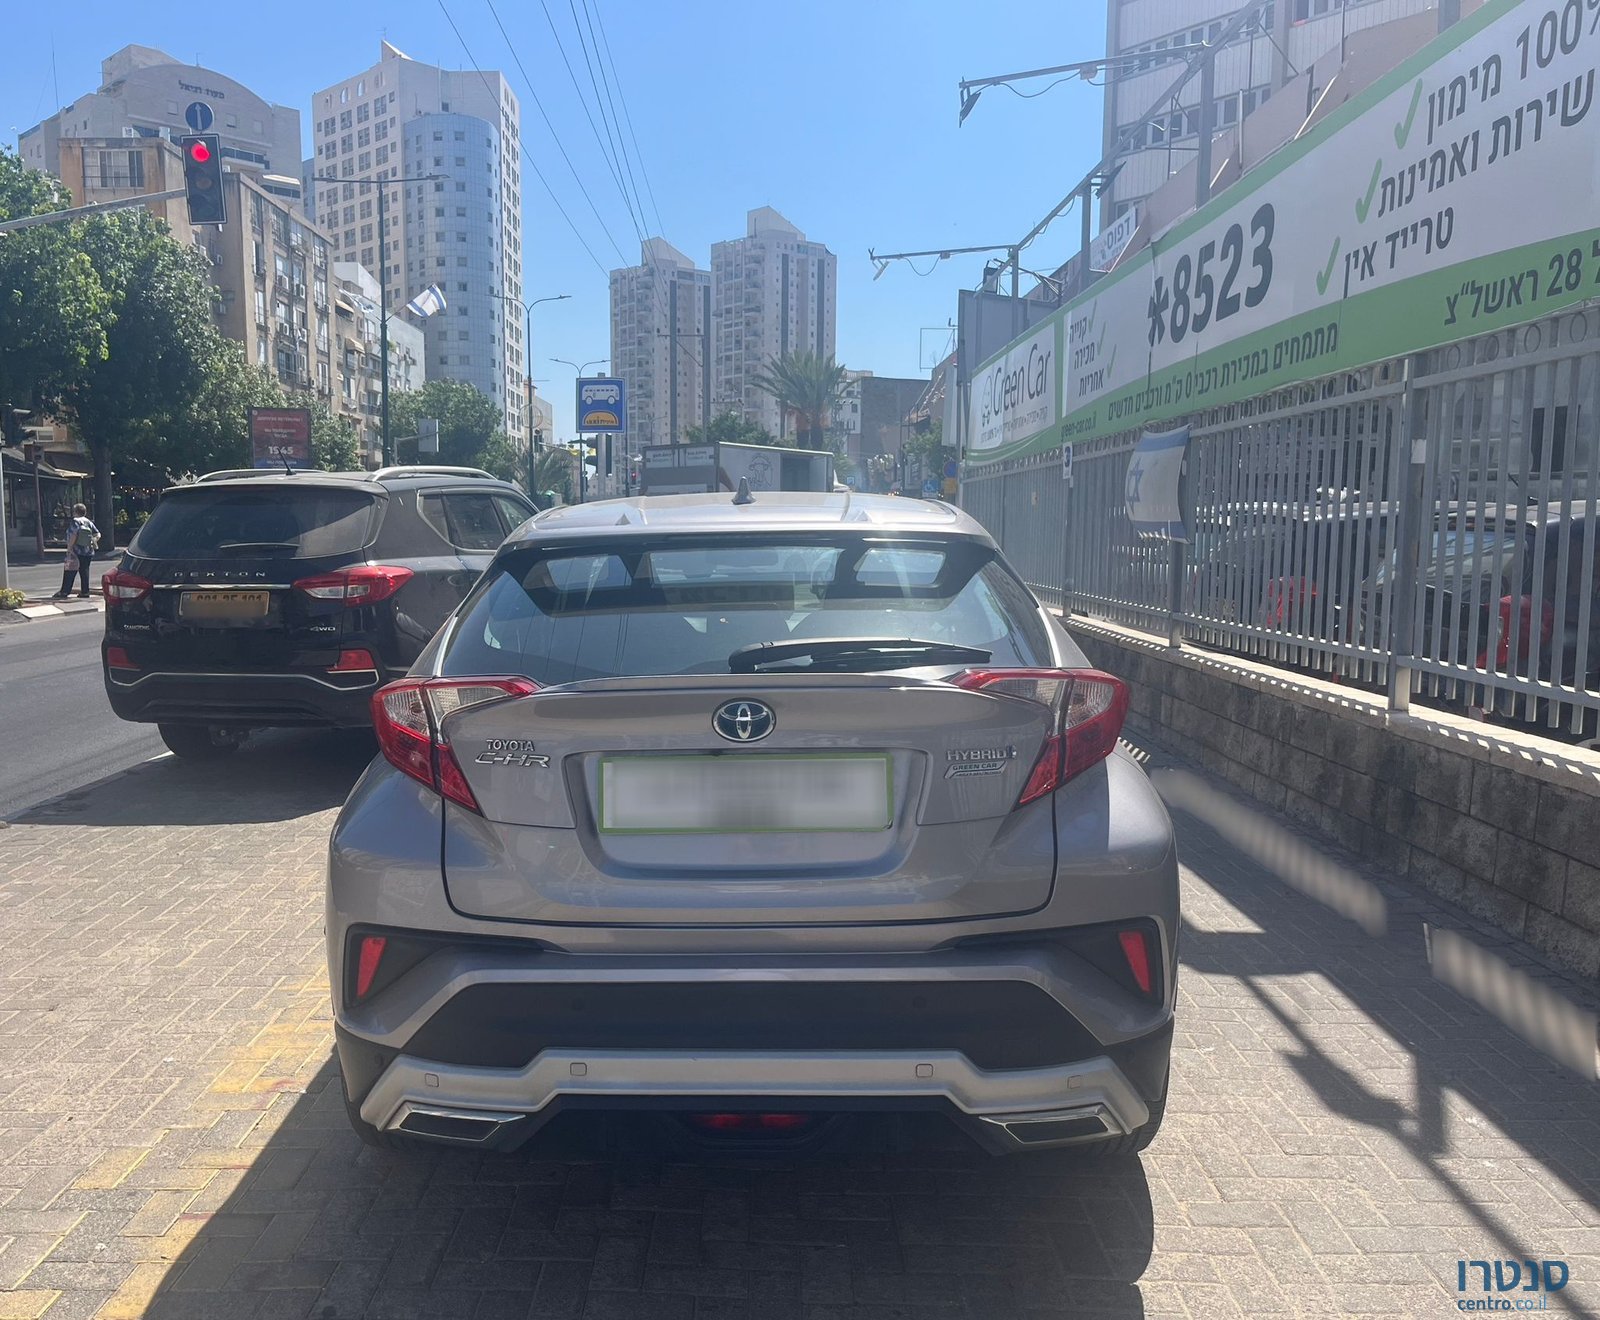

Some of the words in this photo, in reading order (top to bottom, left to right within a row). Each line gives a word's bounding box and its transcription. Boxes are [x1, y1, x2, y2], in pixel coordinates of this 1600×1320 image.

[1427, 54, 1501, 146] מימון
[1488, 68, 1595, 165] שירות
[1378, 129, 1480, 218] ואמינות
[1107, 216, 1130, 250] דפוס
[1385, 207, 1454, 269] טרייד
[1343, 241, 1377, 299] אין
[1546, 248, 1583, 297] 28
[1074, 341, 1095, 370] מכירה
[1273, 322, 1338, 370] מתמחים
[993, 366, 1025, 417] Green
[1027, 343, 1051, 400] Car
[1079, 368, 1104, 397] אחריות
[1195, 366, 1218, 396] רכבי
[1220, 348, 1268, 388] במכירת
[1107, 395, 1134, 421] חדשים
[268, 445, 294, 455] 1945
[474, 752, 550, 768] C-HR
[486, 739, 535, 752] TOYOTA
[946, 748, 1007, 760] HYBRID
[952, 763, 980, 771] GREEN
[981, 762, 997, 770] CAR
